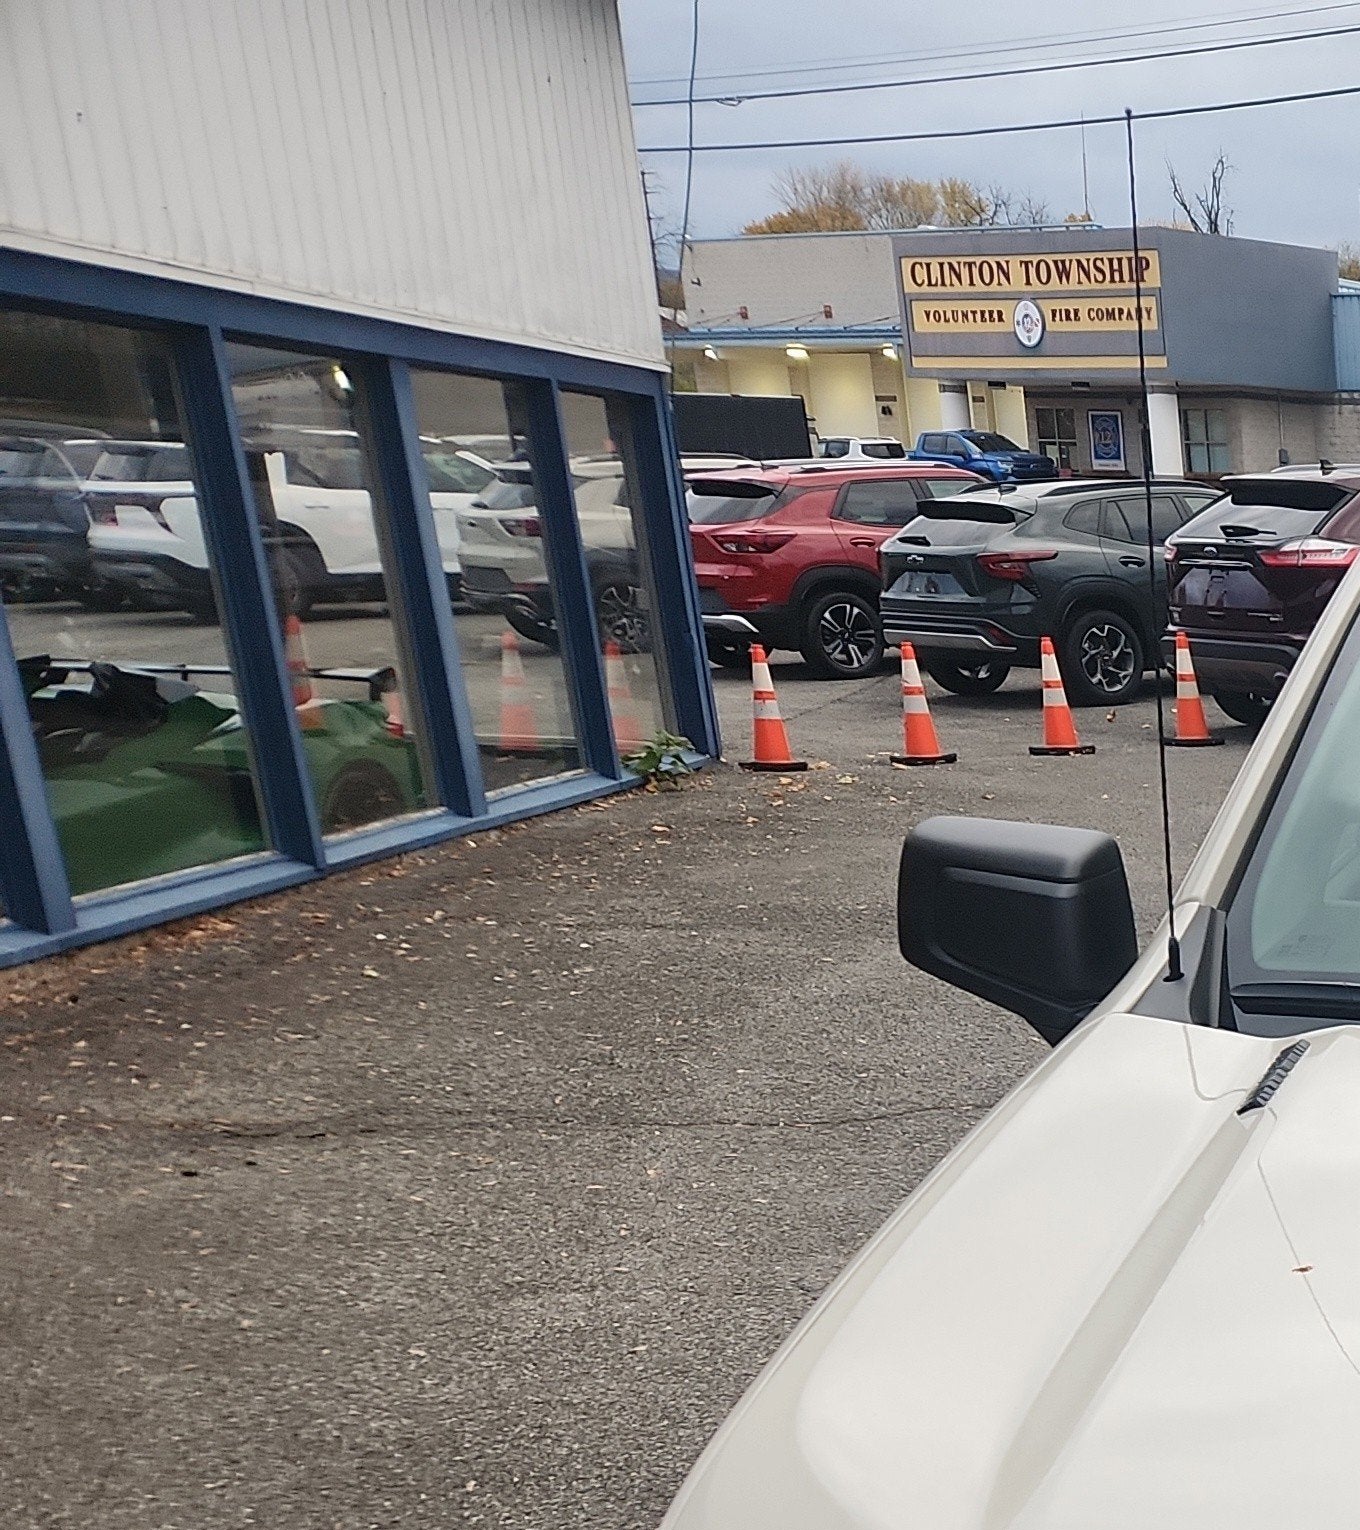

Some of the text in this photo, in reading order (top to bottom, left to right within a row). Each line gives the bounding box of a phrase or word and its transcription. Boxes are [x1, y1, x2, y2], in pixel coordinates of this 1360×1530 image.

[910, 256, 1151, 287] CLINTON TOWNSHIP
[924, 309, 1006, 323] VOLUNTEER
[1051, 307, 1081, 323] FIRE
